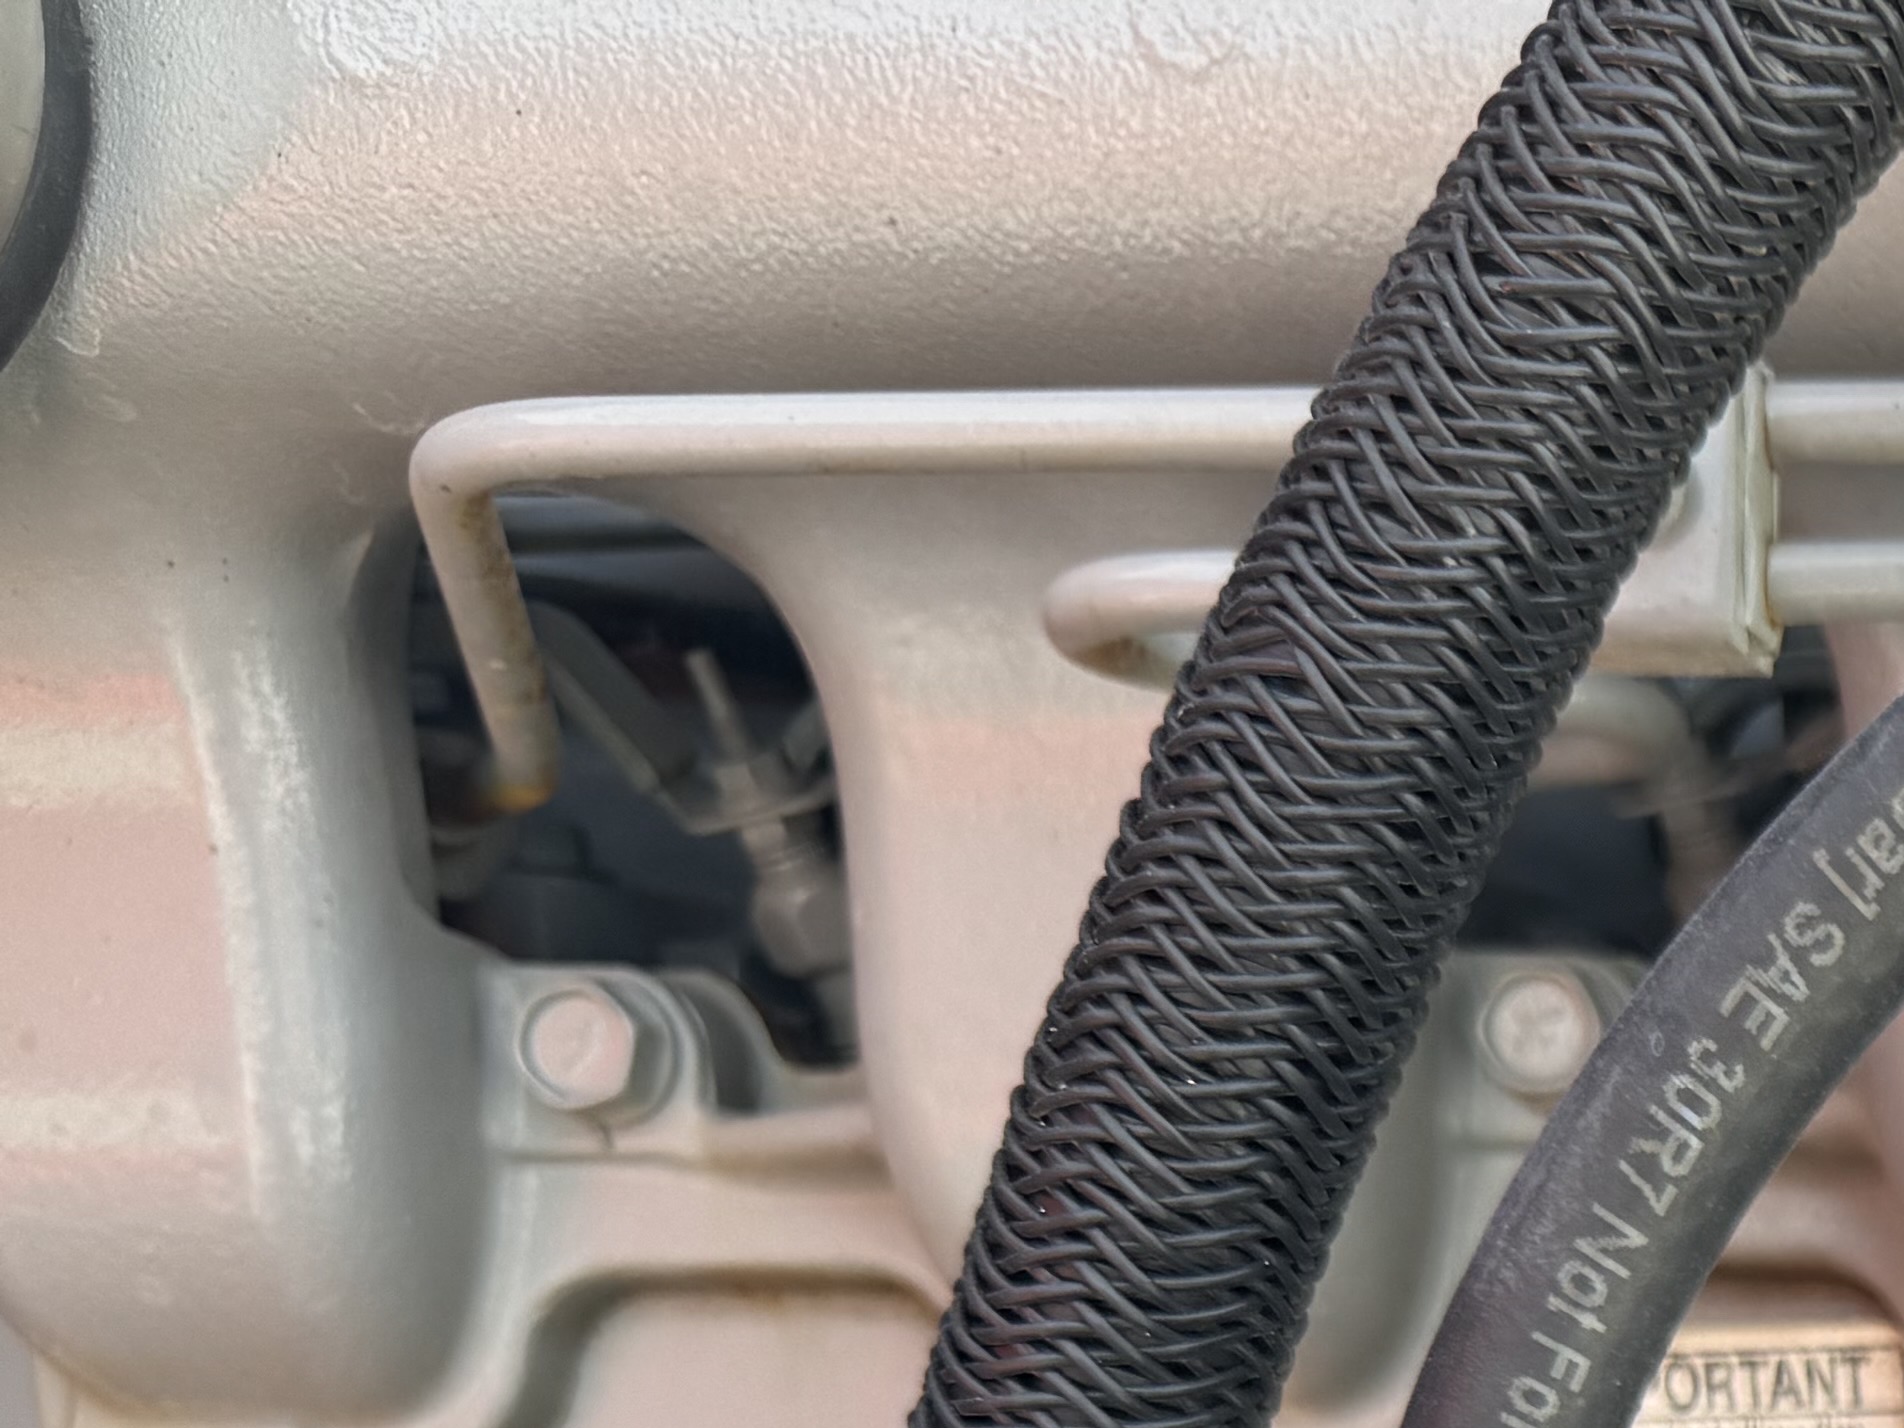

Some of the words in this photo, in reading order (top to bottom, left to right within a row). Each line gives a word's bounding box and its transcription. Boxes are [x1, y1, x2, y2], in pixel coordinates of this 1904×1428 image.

[1719, 900, 1846, 1052] SAE
[1619, 1035, 1746, 1217] 30R7
[1547, 1202, 1649, 1334] Not
[1652, 1355, 1871, 1415] ORTANT
